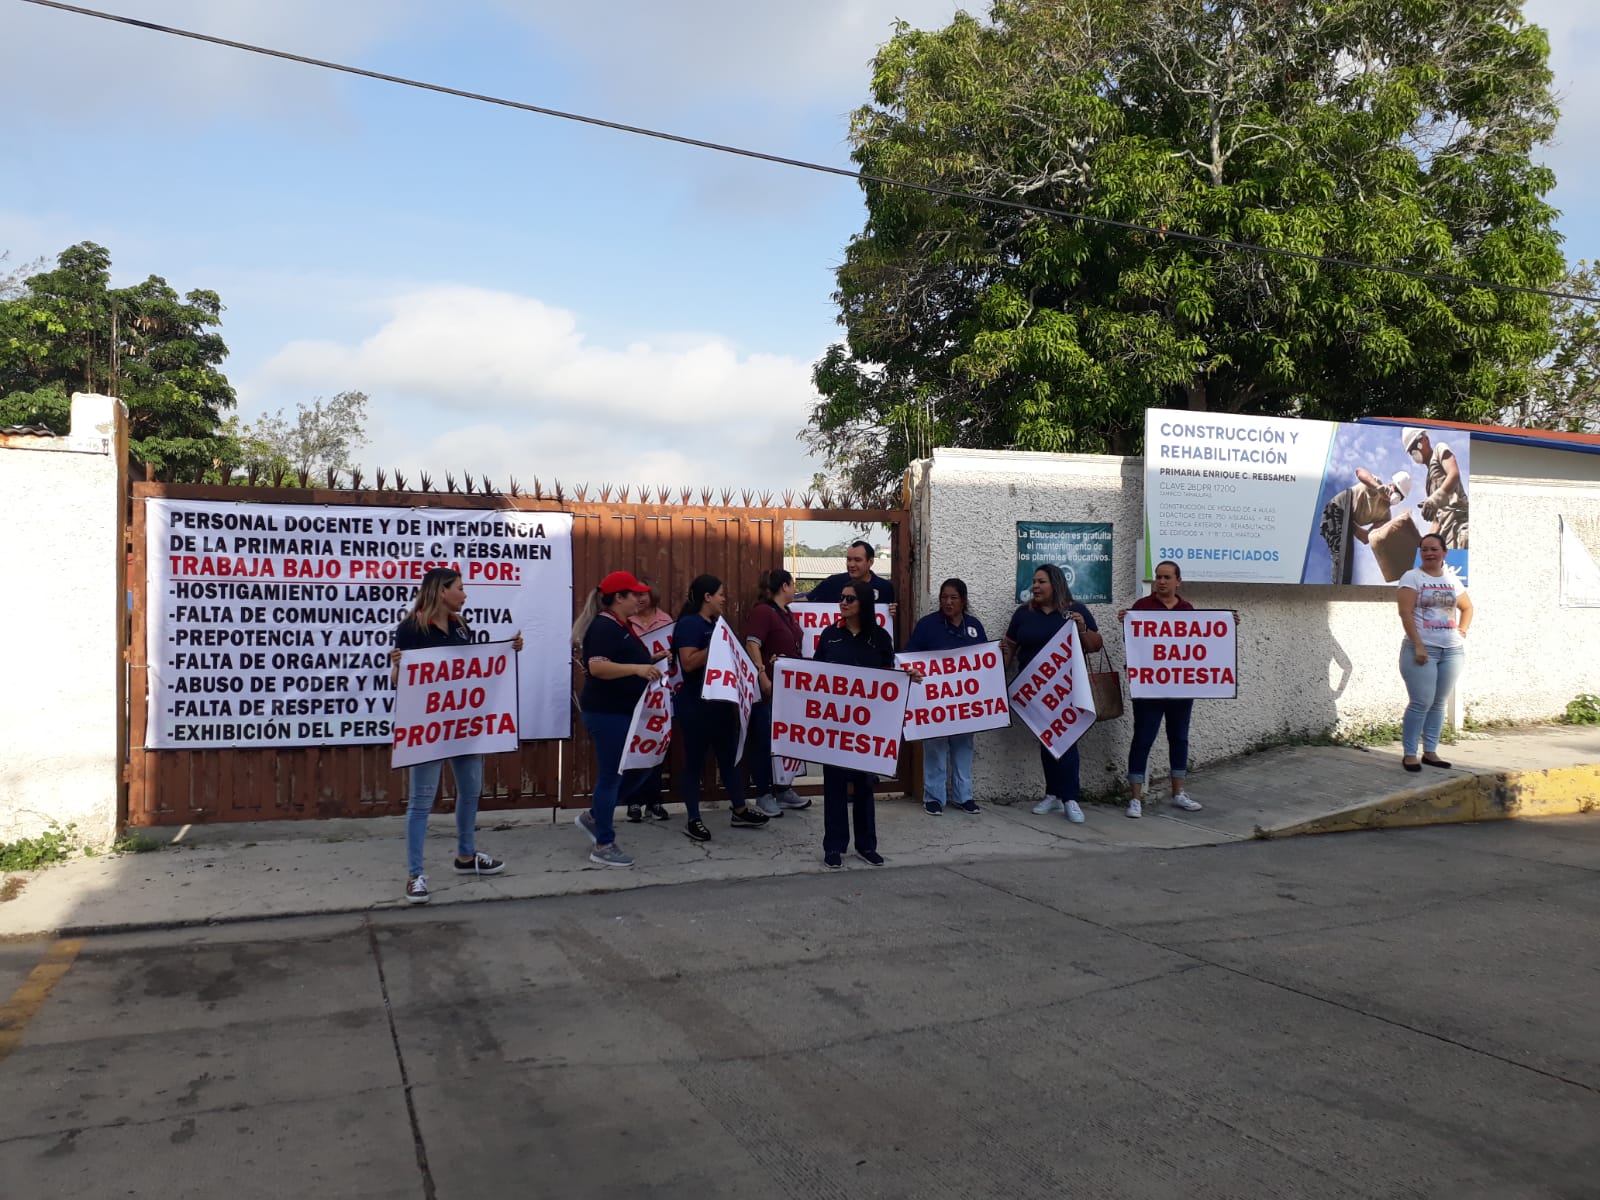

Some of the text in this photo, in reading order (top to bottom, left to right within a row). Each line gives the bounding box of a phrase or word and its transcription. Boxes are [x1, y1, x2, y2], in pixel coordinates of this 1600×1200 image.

[1160, 423, 1299, 445] CONSTRUCCIÓN Y
[1160, 444, 1287, 464] REHABILITACIÓN
[1159, 468, 1296, 482] PRIMARIA ENRIQUE C. REBSAMEN
[1159, 482, 1185, 490] CLAVE
[170, 511, 546, 538] PERSONAL DOCENTE Y DE INTENDENCIA
[1018, 529, 1112, 542] La Educación es gratuita
[170, 534, 196, 552] DE
[203, 536, 227, 553] LA
[234, 537, 334, 556] PRIMARIA
[341, 539, 424, 559] ENRIQUE
[431, 542, 447, 558] C.
[1026, 541, 1103, 551] el mantenimiento de
[1159, 547, 1280, 561] 330 BENEFICIADOS
[1018, 551, 1111, 562] los planteles educativos.
[169, 555, 275, 577] TRABAJA
[283, 558, 341, 578] BAJO
[469, 562, 520, 581] POR:
[169, 582, 420, 602] -HOSTIGAMIENTO LABORA
[169, 606, 233, 623] -FALTA
[240, 606, 266, 623] DE
[272, 604, 408, 624] COMUNICACIÓ
[168, 629, 315, 646] -PREPOTENCIA
[321, 630, 333, 646] Y
[1130, 620, 1228, 638] TRABAJO
[168, 652, 391, 670] -FALTA DE ORGANIZACI
[1153, 644, 1207, 661] BAJO
[407, 655, 507, 686] TRABAJO
[900, 652, 997, 677] TRABAJO
[168, 676, 244, 693] -ABUSO
[250, 676, 276, 693] DE
[283, 675, 349, 692] PODER
[356, 675, 367, 691] Y
[781, 669, 899, 702] TRABAJO
[1127, 667, 1235, 684] PROTESTA
[925, 678, 980, 701] BAJO
[1041, 667, 1072, 712] BAJ
[168, 700, 233, 717] -FALTA
[239, 699, 265, 716] DE
[271, 698, 359, 716] RESPETO
[365, 697, 376, 713] Y
[425, 687, 486, 714] BAJO
[805, 699, 871, 726] BAJO
[903, 697, 1008, 727] PROTESTA
[168, 719, 291, 741] -EXHIBICIÓN
[298, 722, 334, 738] DEL
[393, 712, 516, 750] PROTESTA
[772, 721, 898, 760] PROTESTA
